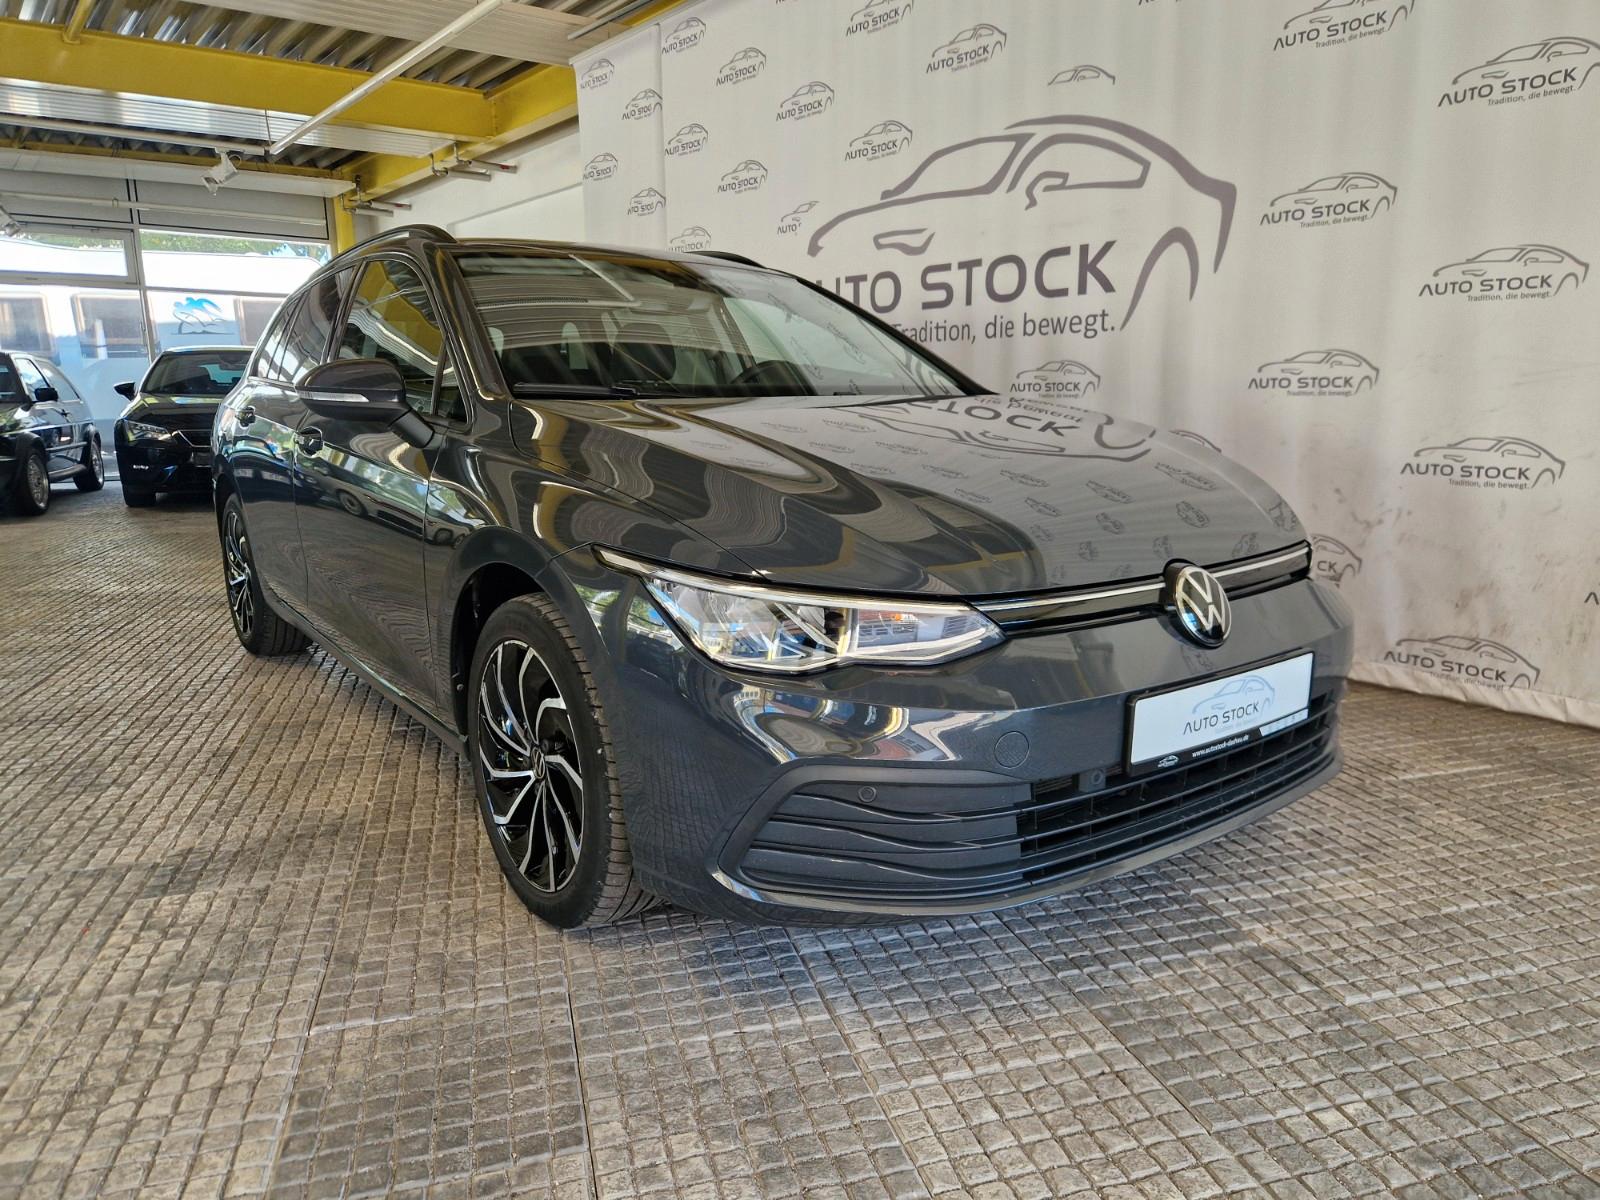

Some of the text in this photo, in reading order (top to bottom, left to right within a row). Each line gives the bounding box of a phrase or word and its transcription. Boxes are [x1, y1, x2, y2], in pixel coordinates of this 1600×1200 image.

[846, 20, 869, 37] AUTO
[872, 8, 900, 27] STOCK
[1274, 10, 1387, 51] AUTO STOCK
[662, 42, 678, 54] AUTO
[678, 33, 698, 48] STOCK
[926, 56, 954, 74] AUTO
[956, 44, 990, 64] STOCK
[716, 73, 734, 86] AUTO
[734, 64, 757, 78] STOCK
[1438, 66, 1578, 107] AUTO STOCK
[776, 108, 796, 122] AUTO
[798, 98, 823, 115] STOCK
[1488, 96, 1526, 106] Tradition,
[1528, 92, 1540, 100] die
[680, 140, 700, 152] STOCK
[844, 148, 869, 161] AUTO
[870, 138, 898, 155] STOCK
[718, 182, 736, 192] AUTO
[738, 176, 759, 188] STOCK
[1260, 198, 1370, 226] AUTO STOCK
[777, 224, 797, 235] AUTO
[920, 240, 1118, 311] STOCK
[1418, 274, 1553, 297] AUTO STOCK
[984, 314, 1015, 338] die
[1022, 309, 1115, 339] bewegt.
[1010, 382, 1081, 392] AUTO STOCK
[1248, 376, 1353, 390] AUTO STOCK
[1400, 462, 1530, 481] AUTO STOCK
[1384, 650, 1435, 669] AUTO
[1440, 660, 1507, 682] STOCK
[1183, 714, 1218, 736] AUTO
[1222, 700, 1260, 724] STOCK
